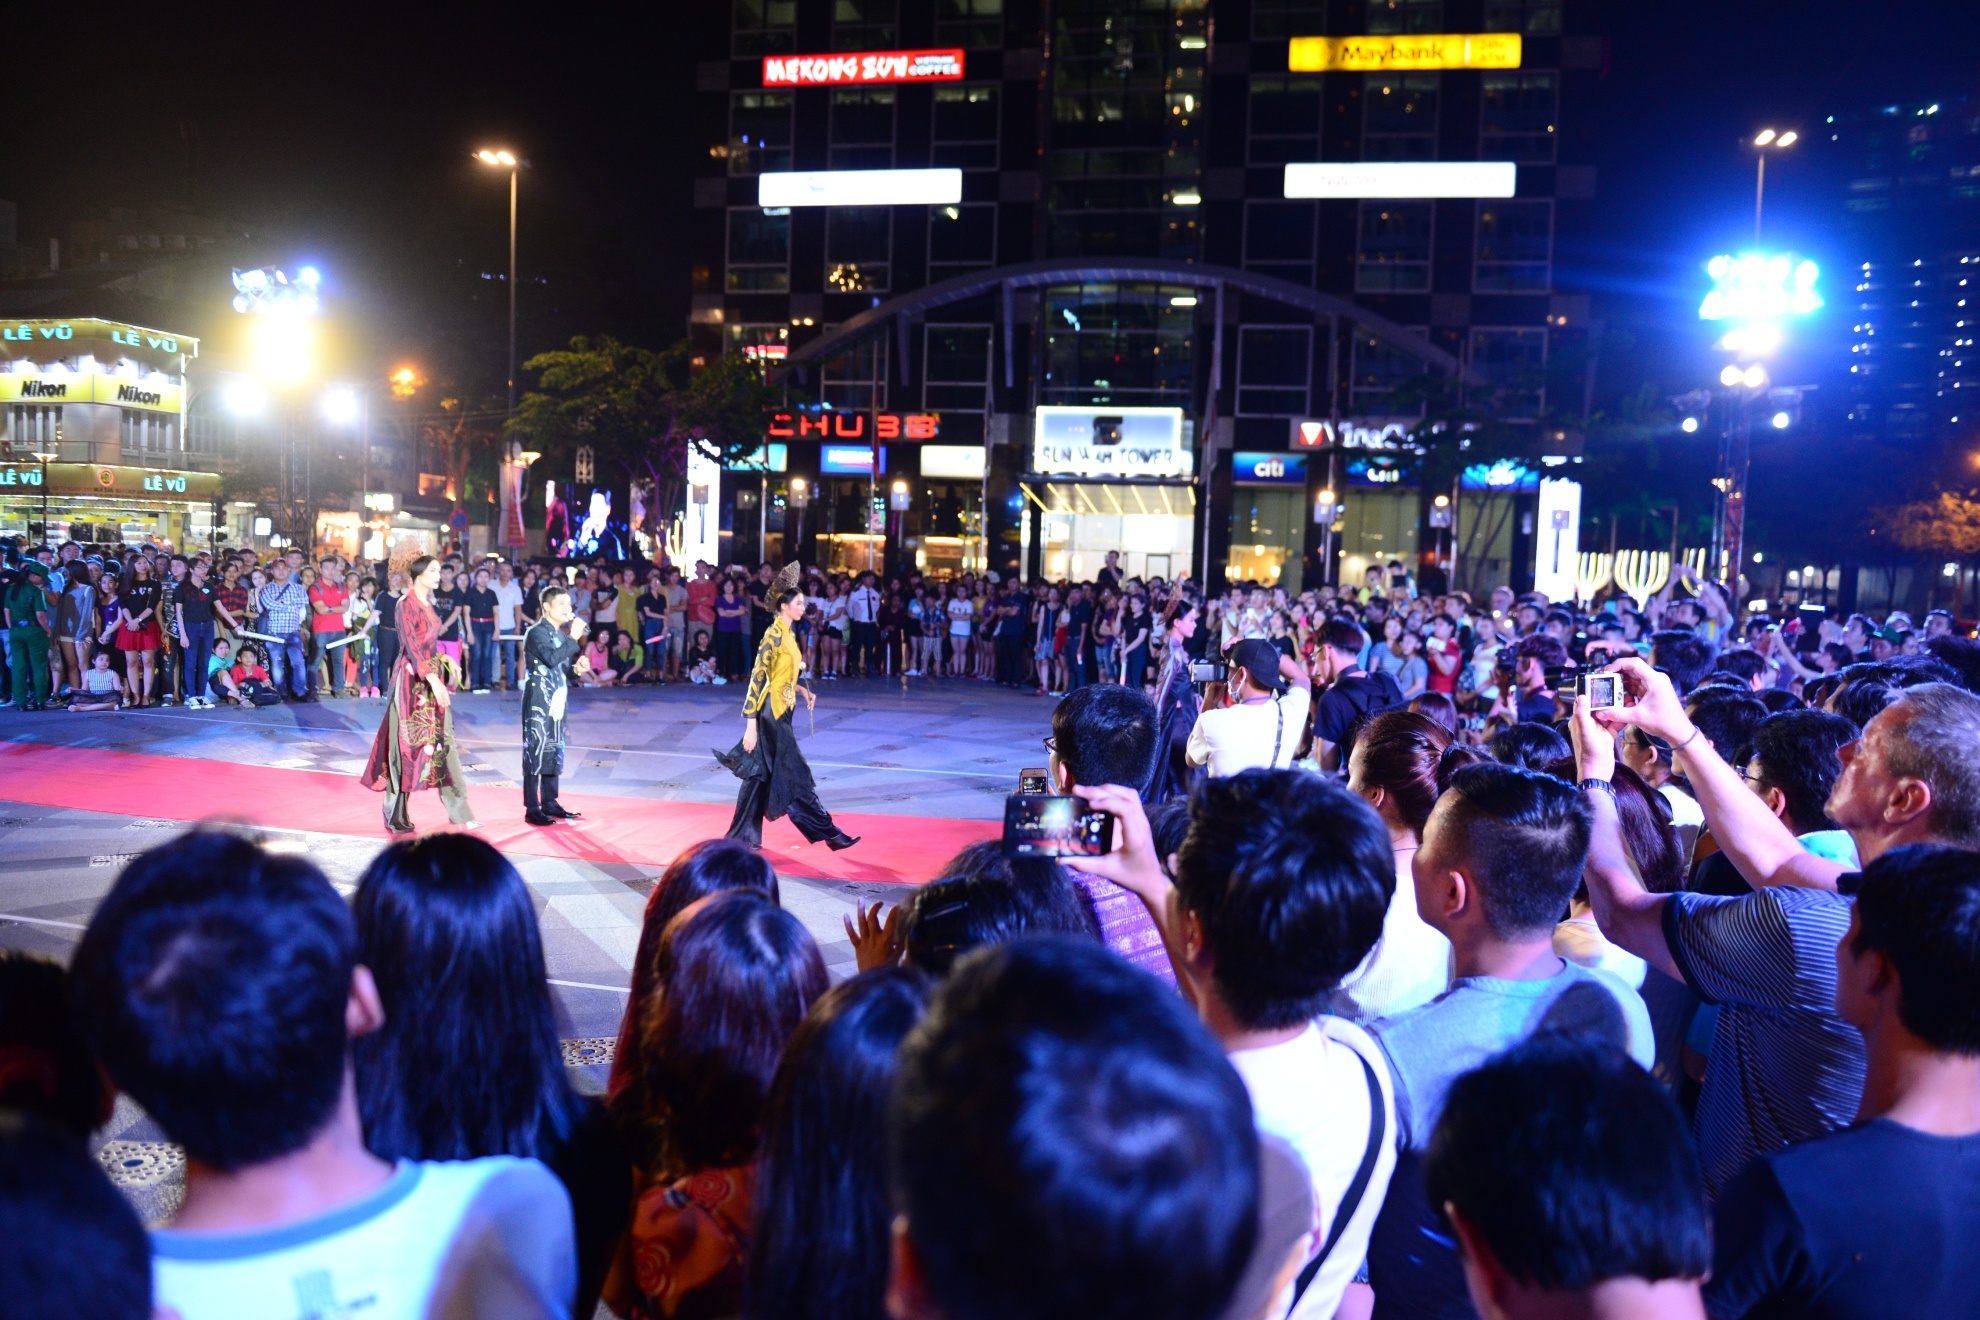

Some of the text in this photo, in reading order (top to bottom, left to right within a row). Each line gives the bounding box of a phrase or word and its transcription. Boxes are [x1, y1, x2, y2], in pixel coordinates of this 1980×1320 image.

[1342, 42, 1444, 63] Maybank
[765, 55, 908, 83] MEKONG SUN
[908, 63, 962, 77] COFFEE
[3, 324, 33, 341] LÊ
[112, 330, 141, 347] LÊ
[21, 380, 67, 397] Nikon
[118, 384, 161, 405] Nikon
[1119, 447, 1173, 464] TOWER
[1254, 458, 1285, 478] citi
[144, 475, 163, 491] LÊ
